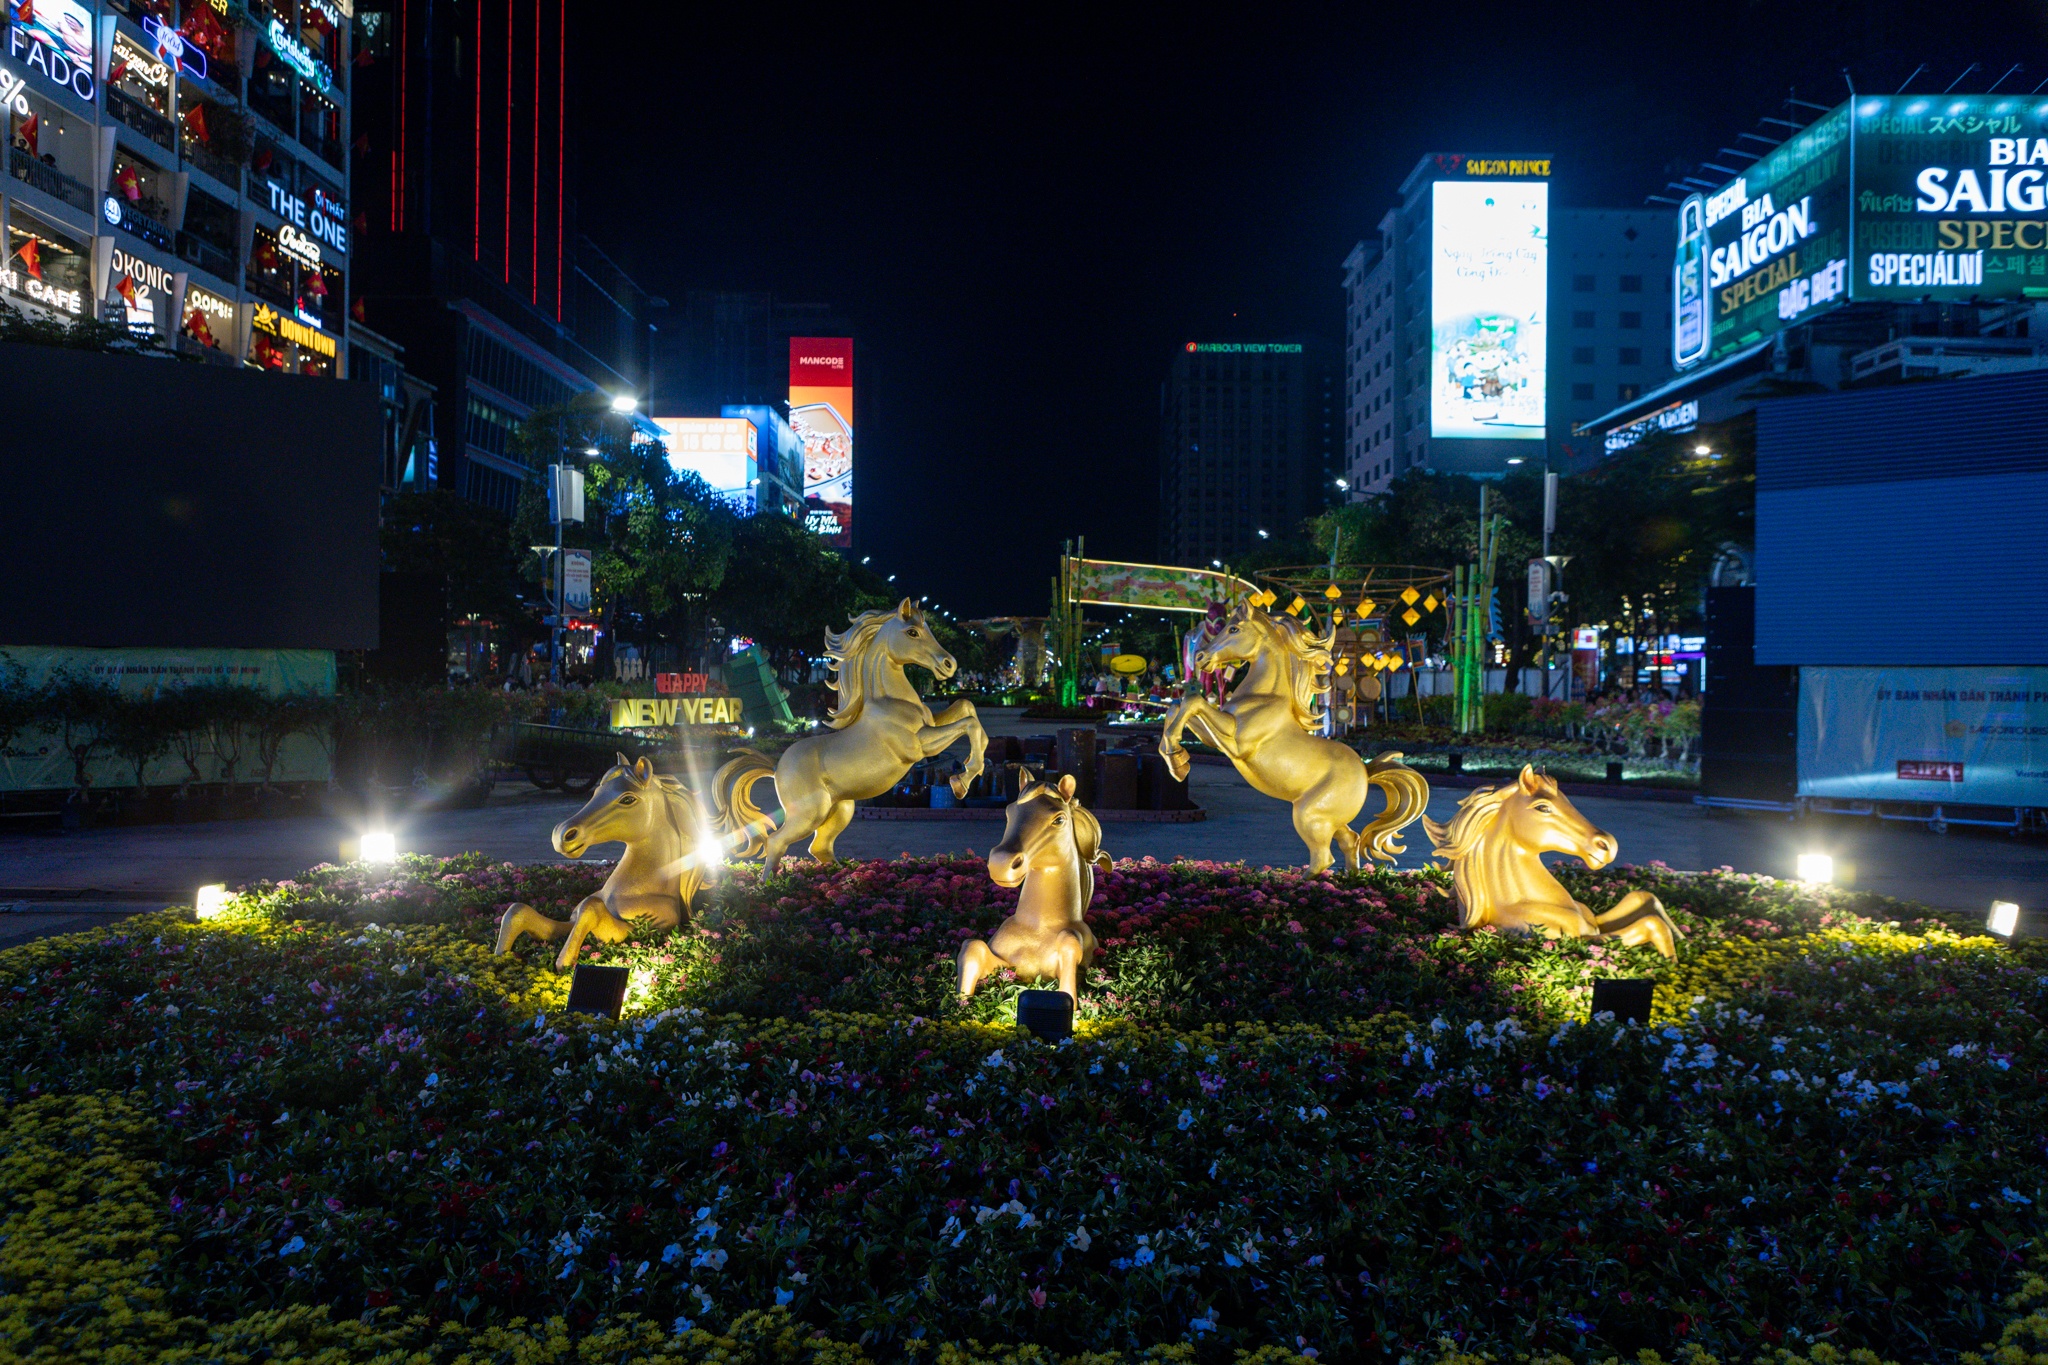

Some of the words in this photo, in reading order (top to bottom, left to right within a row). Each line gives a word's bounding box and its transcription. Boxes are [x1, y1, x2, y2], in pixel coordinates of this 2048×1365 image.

[161, 31, 181, 52] 1664
[272, 19, 315, 78] Carlsberg
[12, 26, 94, 100] FADO
[1861, 114, 1925, 135] SPÉCIAL
[1928, 116, 2022, 135] スペシャル
[1466, 159, 1508, 175] SAIGON
[1509, 160, 1551, 176] PRINCE
[1989, 138, 2048, 166] BIA
[1917, 167, 2048, 212] SAIG
[267, 180, 305, 229] THE
[310, 210, 346, 253] ONE
[1742, 193, 1775, 232] BIA
[1710, 196, 1811, 288] SAIGON
[1721, 252, 1803, 316] SPECIAL
[1869, 250, 1984, 287] SPECIÁLNÍ
[1778, 277, 1810, 321] ĐẶC
[1811, 259, 1847, 305] BIỆT
[800, 356, 844, 366] MANCODE
[1197, 344, 1242, 354] HARBOUR
[1243, 344, 1267, 354] VIEW
[1268, 344, 1303, 354] TOWER
[656, 673, 708, 693] HAPPY
[612, 698, 678, 727] NEW
[683, 697, 743, 724] YEAR
